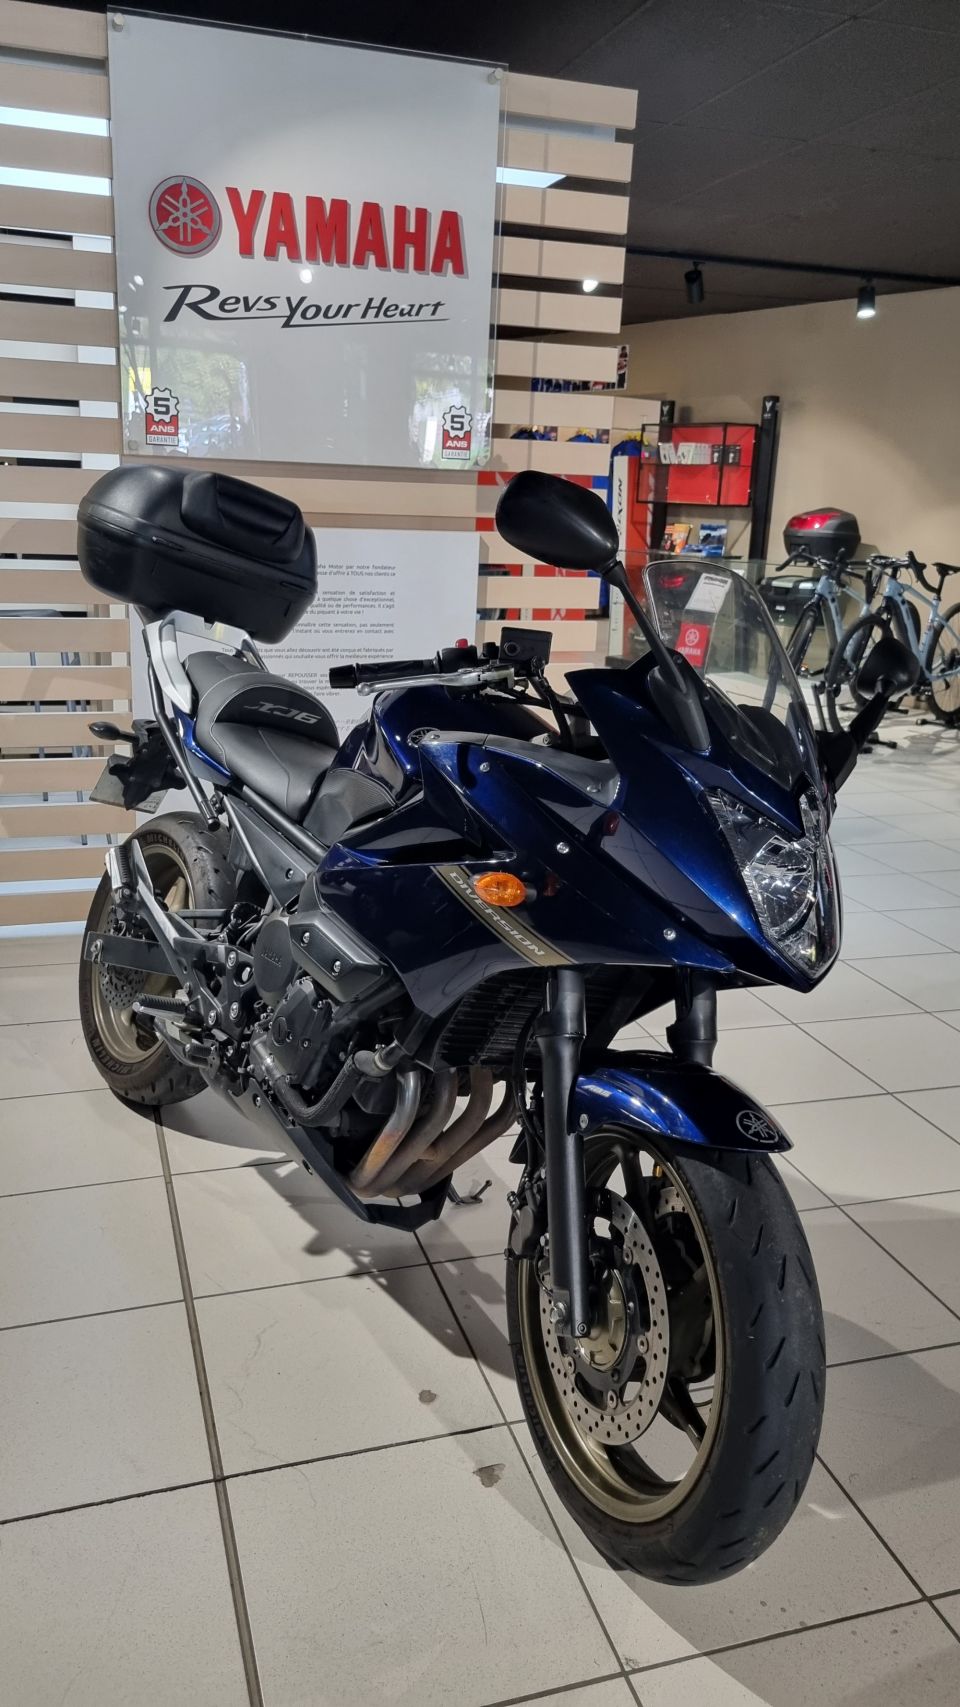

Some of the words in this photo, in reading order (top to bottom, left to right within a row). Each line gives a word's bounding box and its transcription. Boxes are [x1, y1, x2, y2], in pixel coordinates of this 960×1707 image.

[226, 187, 468, 279] YAMAHA
[163, 284, 282, 323] Revs
[280, 295, 362, 329] Your
[360, 296, 448, 321] Heart
[153, 397, 171, 415] 5
[150, 425, 176, 433] ANS
[450, 414, 466, 431] 5
[148, 436, 177, 444] GARANTIE
[445, 440, 468, 448] ANS
[449, 872, 545, 956] DIVERSION
